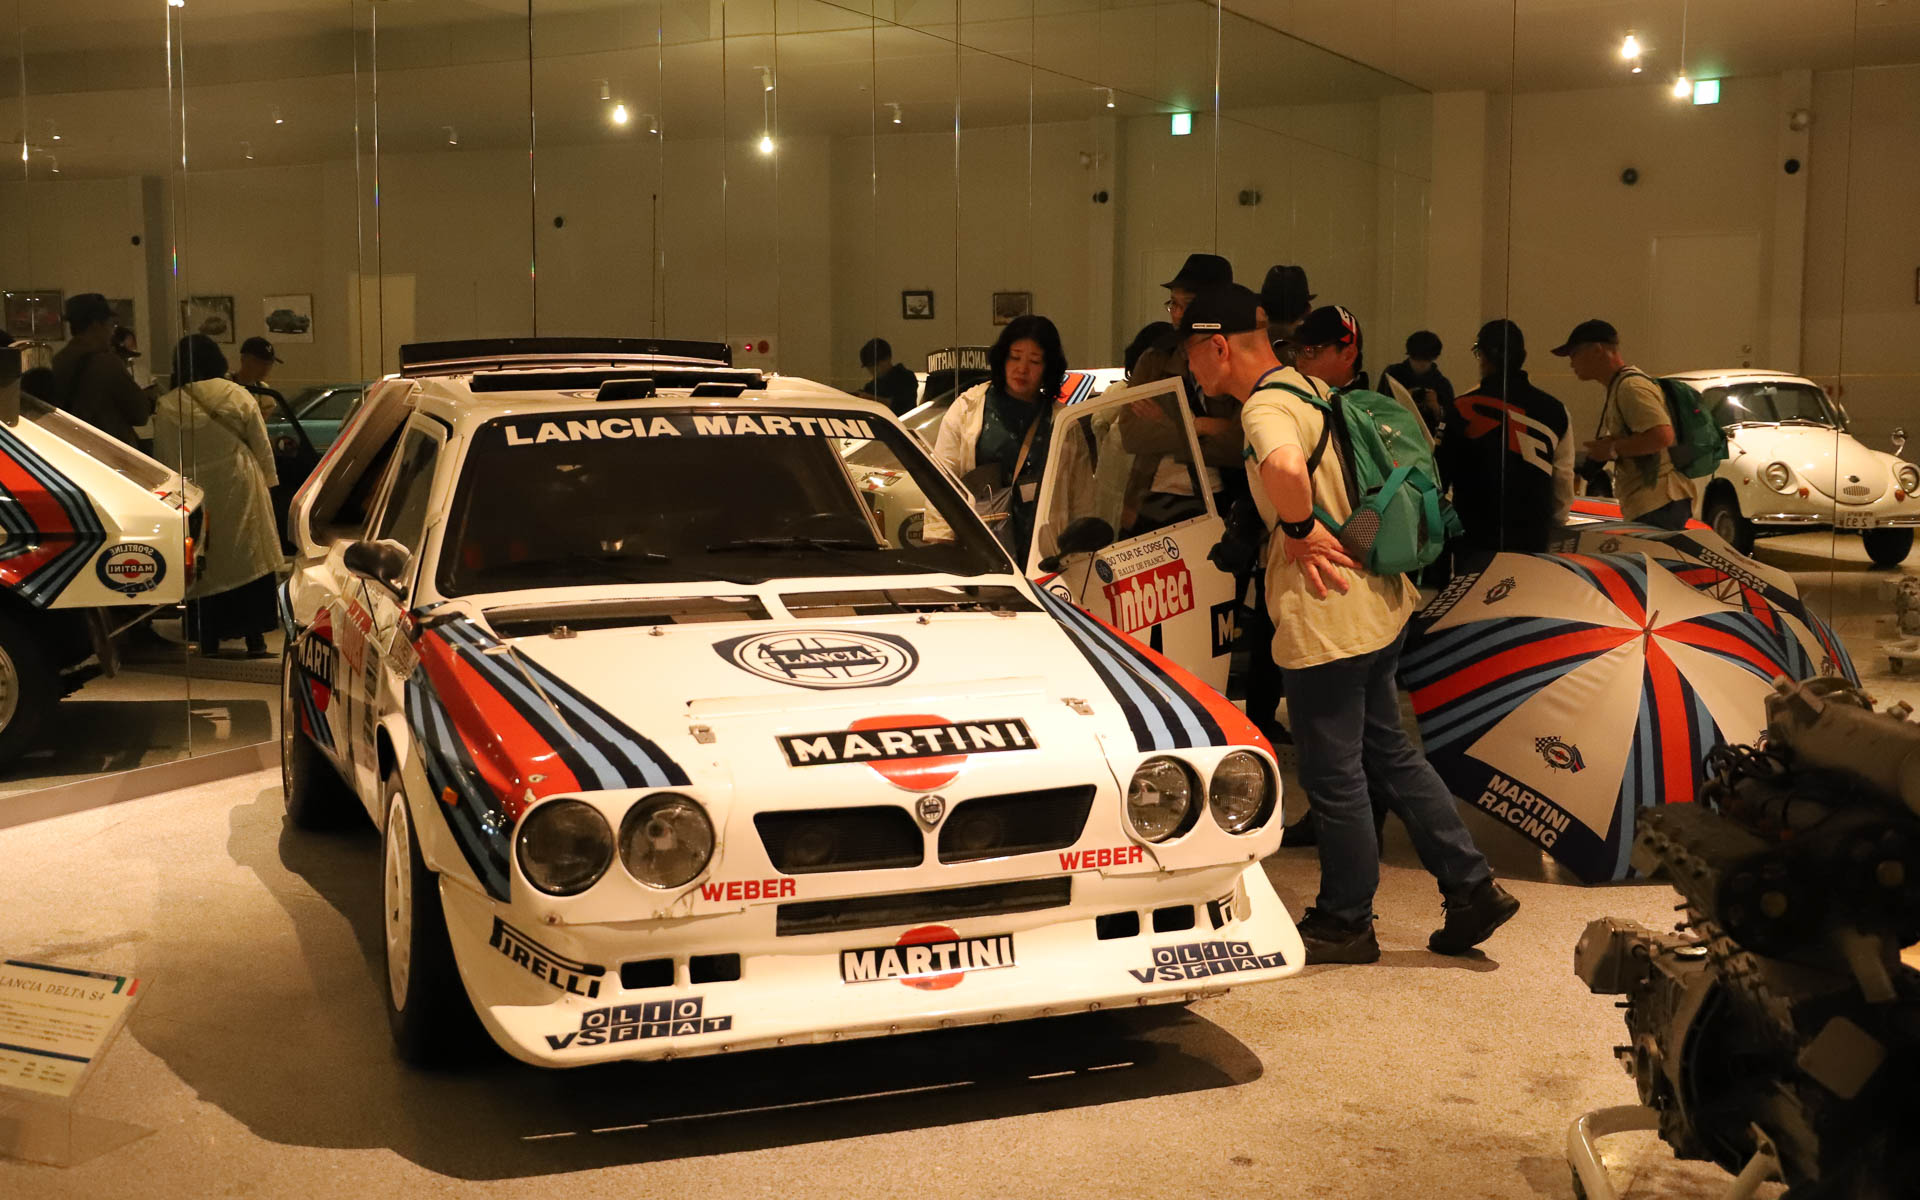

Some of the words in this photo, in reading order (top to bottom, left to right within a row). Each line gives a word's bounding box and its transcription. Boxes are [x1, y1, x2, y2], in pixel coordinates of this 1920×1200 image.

[505, 416, 682, 446] LANCIA
[692, 415, 876, 439] MARTINI
[1116, 550, 1135, 563] TOUR
[1133, 547, 1143, 557] DE
[1143, 541, 1164, 554] CORSE
[1110, 570, 1190, 633] infotec
[777, 651, 876, 665] LANCIA
[790, 722, 1026, 763] MARTINI
[1488, 774, 1571, 833] MARTINI
[1478, 791, 1557, 848] RACING
[1059, 845, 1143, 871] WEBER
[700, 878, 796, 902] WEBER
[489, 914, 606, 999] PIRELLI
[843, 936, 1011, 982] MARTINI
[1156, 943, 1250, 965] OLIO
[45, 983, 86, 999] DELTA
[89, 991, 105, 1001] S4
[584, 1000, 699, 1028] OLIO
